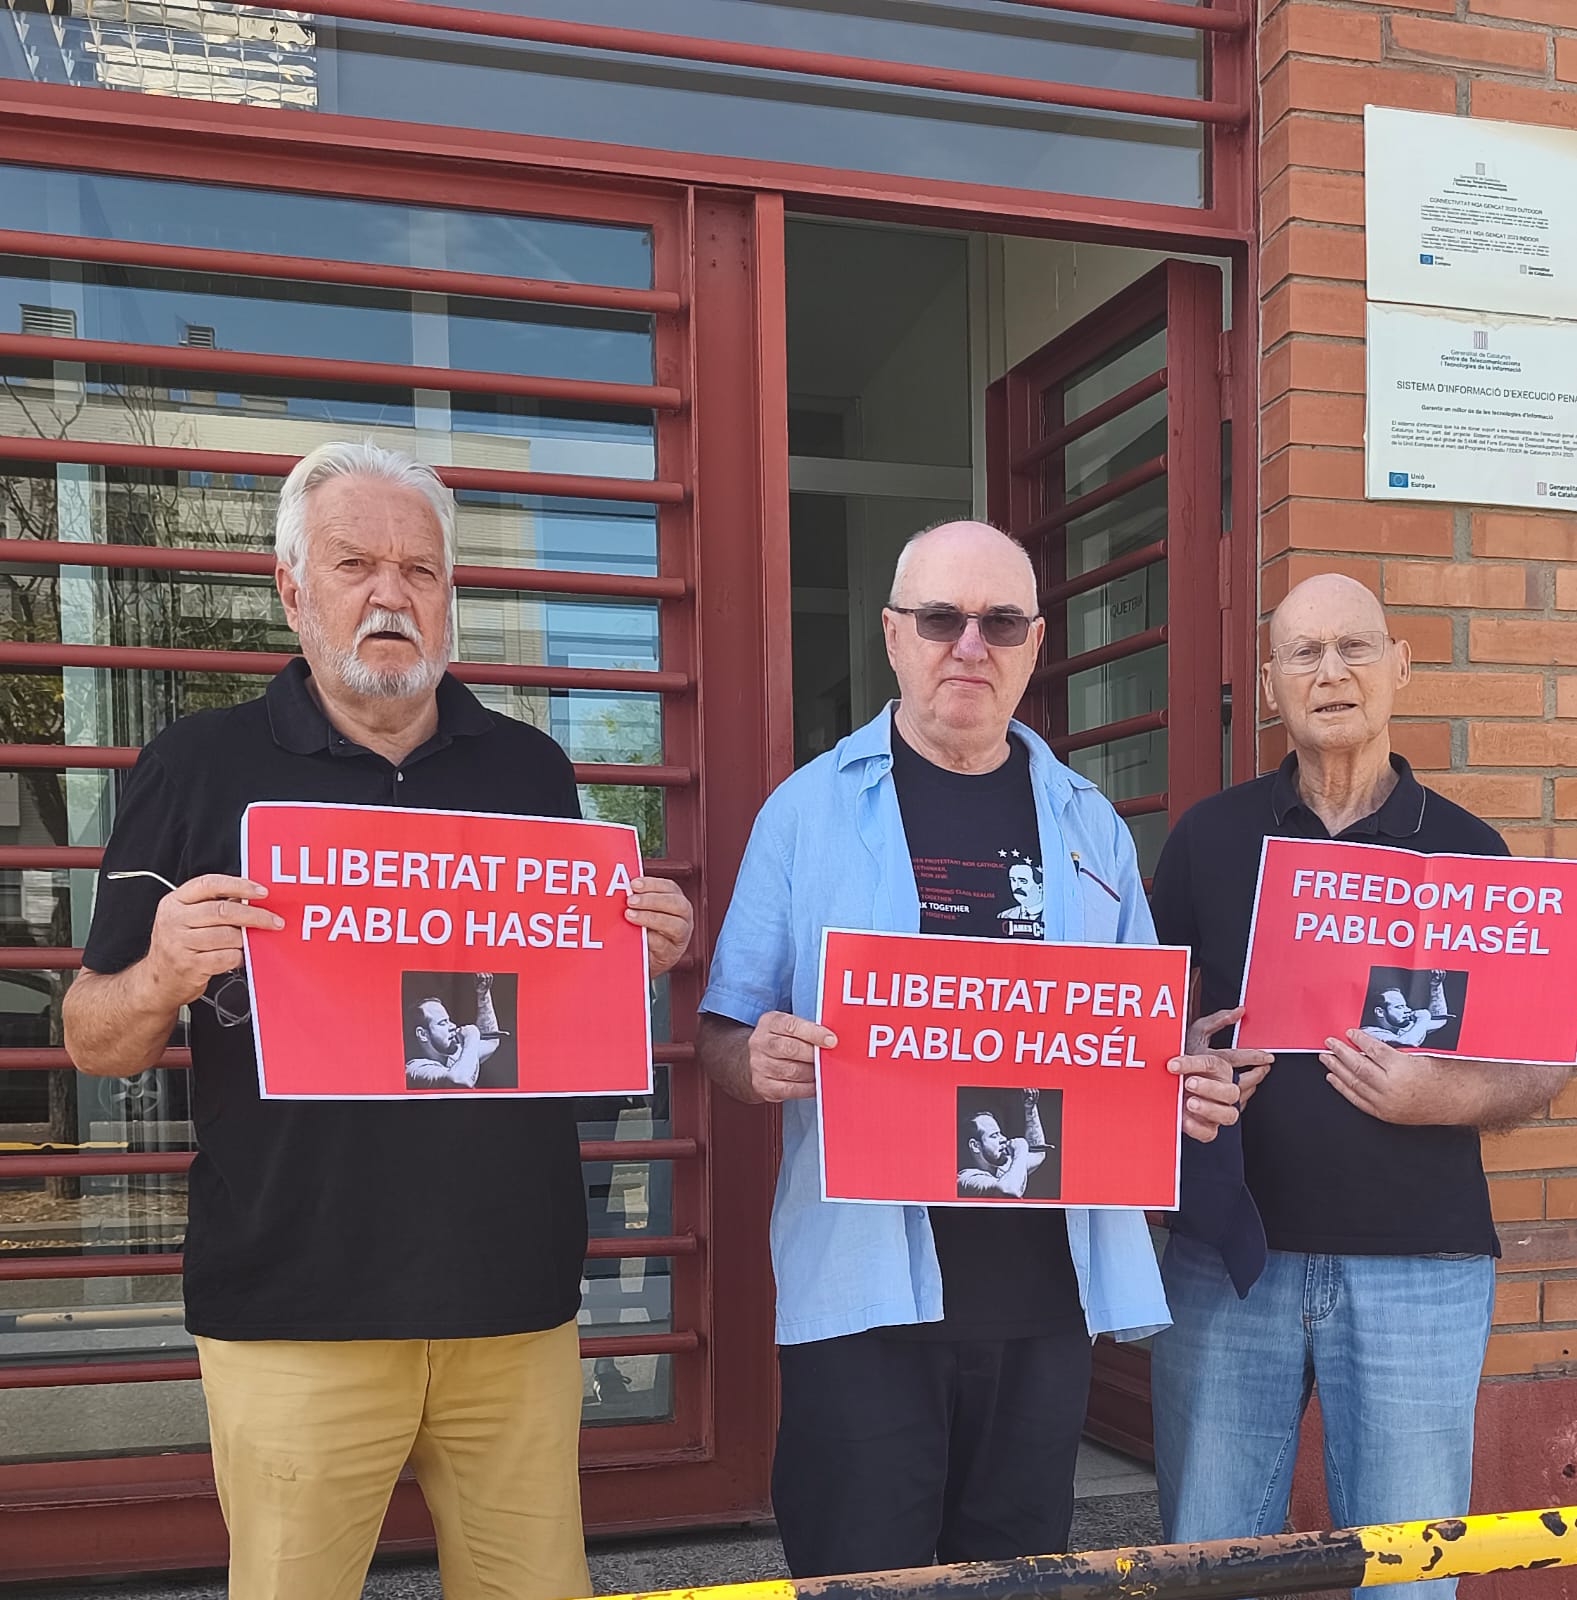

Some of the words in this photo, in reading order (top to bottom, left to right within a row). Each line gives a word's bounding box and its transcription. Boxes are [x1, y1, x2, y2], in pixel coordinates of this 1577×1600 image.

[1396, 380, 1436, 392] SISTEMA
[1437, 384, 1501, 397] D'INFORMACIÓ
[1504, 388, 1555, 401] D'EXECUCIÓ
[271, 845, 506, 892] LLIBERTAT
[516, 858, 598, 896] PER
[606, 863, 633, 898] A
[1292, 869, 1474, 911] FREEDOM
[1483, 885, 1563, 914] FOR
[302, 904, 453, 945] PABLO
[465, 905, 603, 949] HASÉL
[928, 902, 970, 913] TOGETHER
[1294, 912, 1415, 948] PABLO
[1424, 921, 1550, 955] HASÉL
[842, 970, 1058, 1014] LLIBERTAT
[1064, 981, 1142, 1018] PER
[1150, 985, 1177, 1018] A
[868, 1024, 1004, 1062] PABLO
[1014, 1026, 1146, 1068] HASÉL
